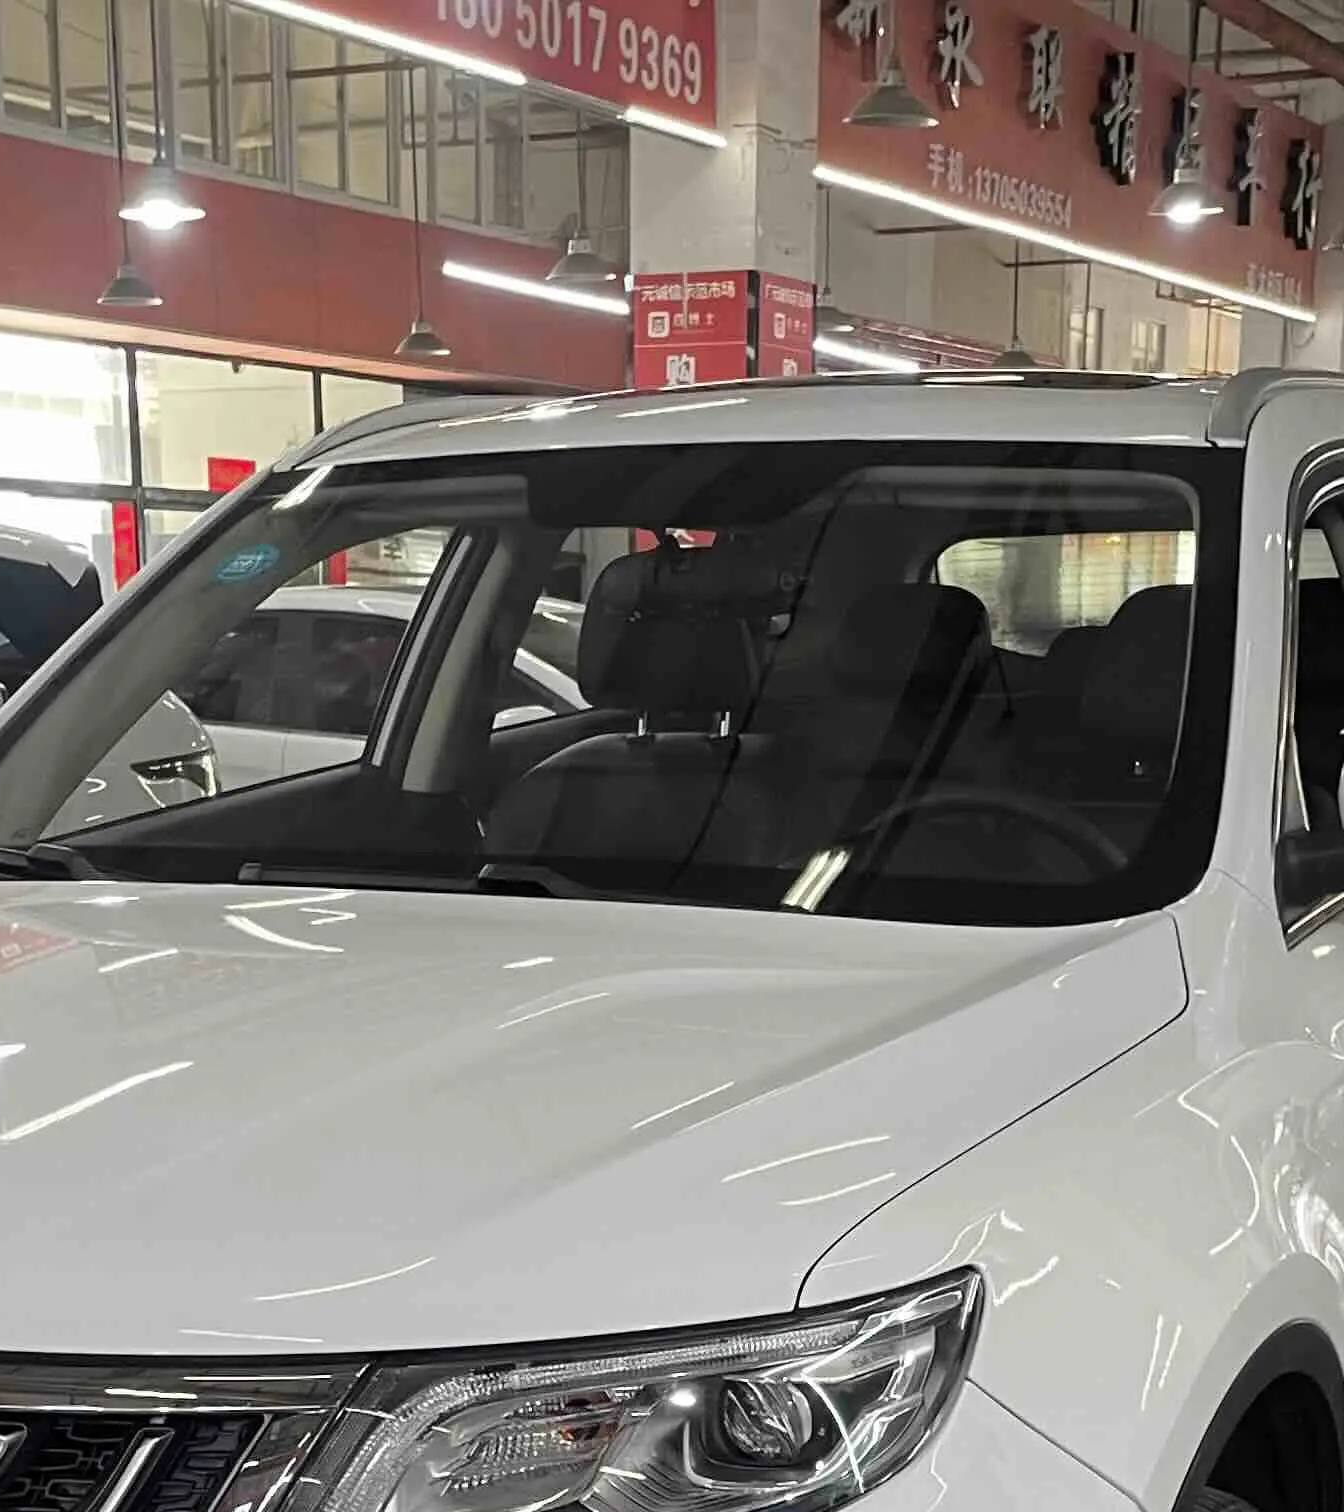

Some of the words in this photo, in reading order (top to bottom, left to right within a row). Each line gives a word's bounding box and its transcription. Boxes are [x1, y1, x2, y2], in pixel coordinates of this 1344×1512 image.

[619, 17, 701, 104] 9369
[632, 281, 736, 302] 元诚信示范市场
